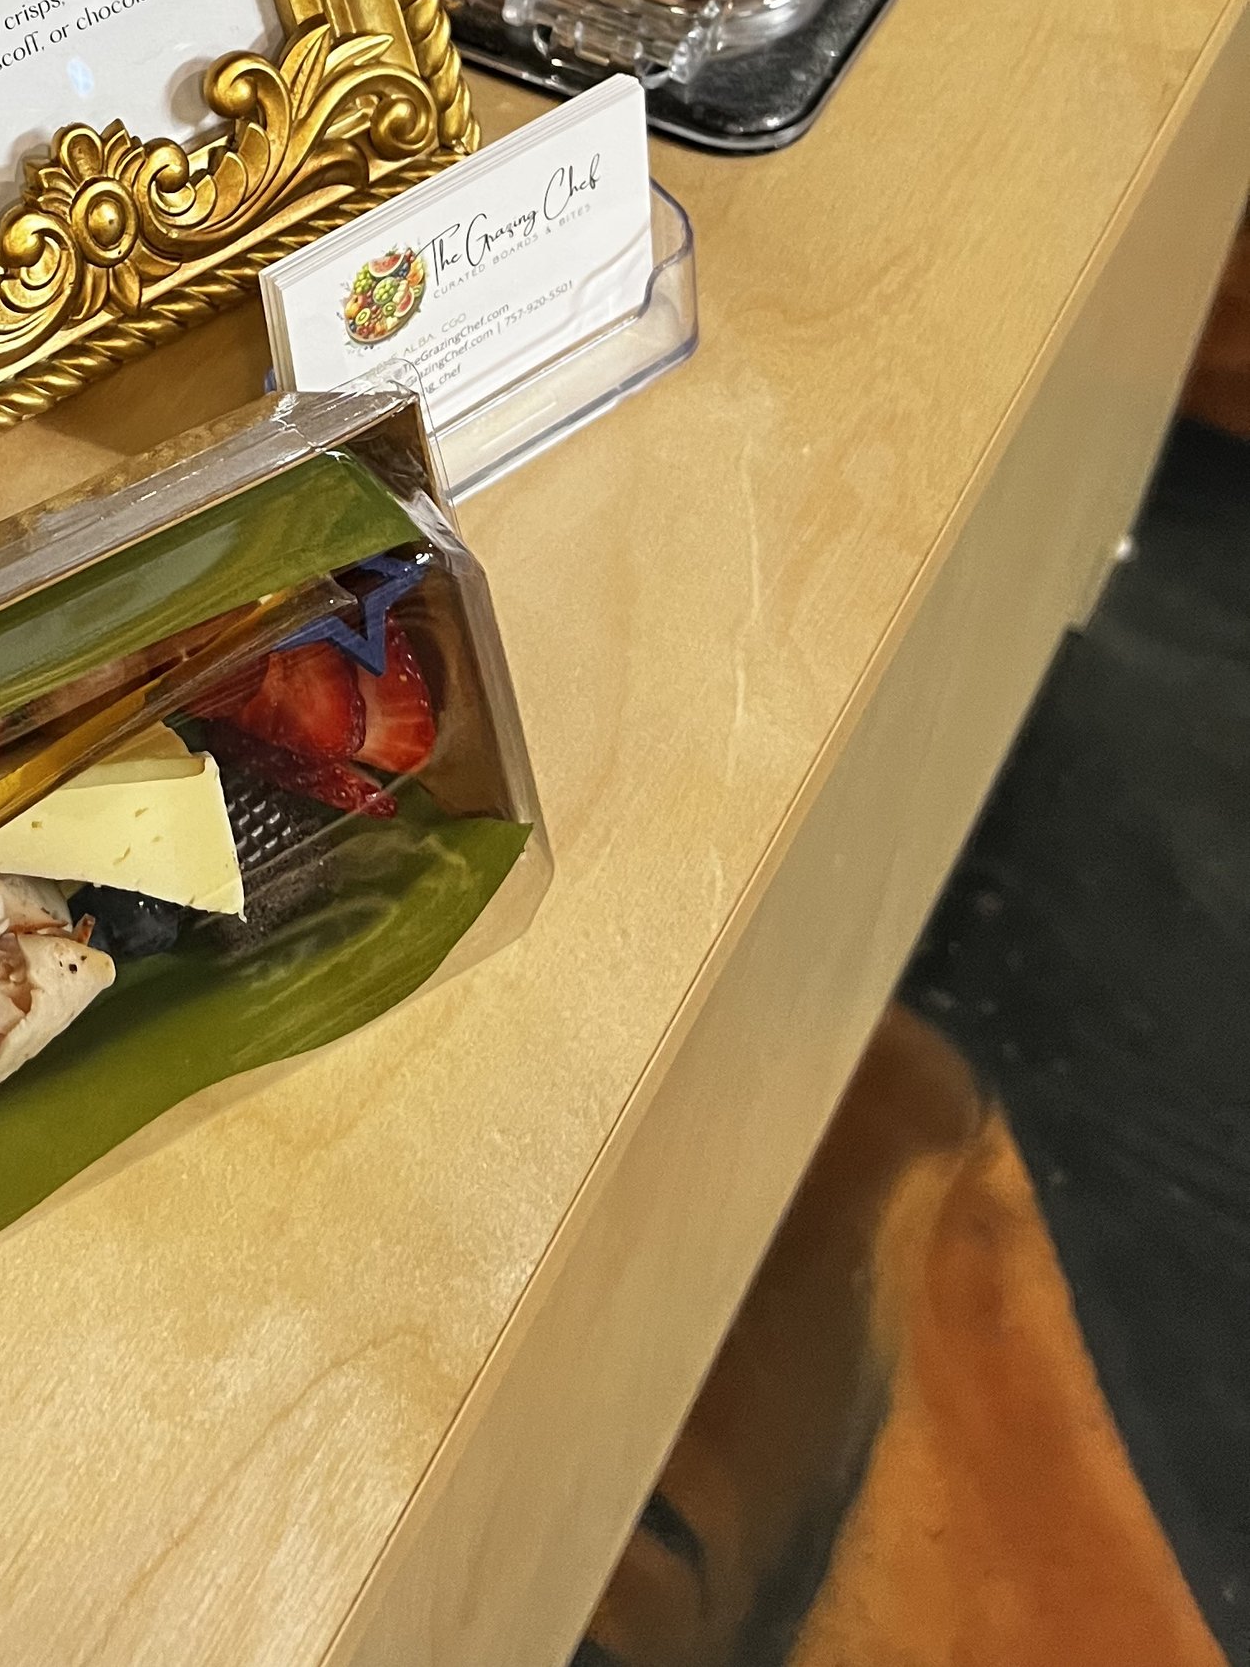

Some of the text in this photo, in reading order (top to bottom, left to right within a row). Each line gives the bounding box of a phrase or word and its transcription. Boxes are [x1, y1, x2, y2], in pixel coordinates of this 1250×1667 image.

[49, 24, 70, 44] or
[414, 153, 601, 286] The Grazing Chef
[433, 263, 486, 299] CURATED
[492, 233, 539, 265] BOARDS
[558, 203, 592, 227] BITES
[394, 302, 510, 378] TheGrazingChef.com
[504, 280, 573, 328] 757-920-5501
